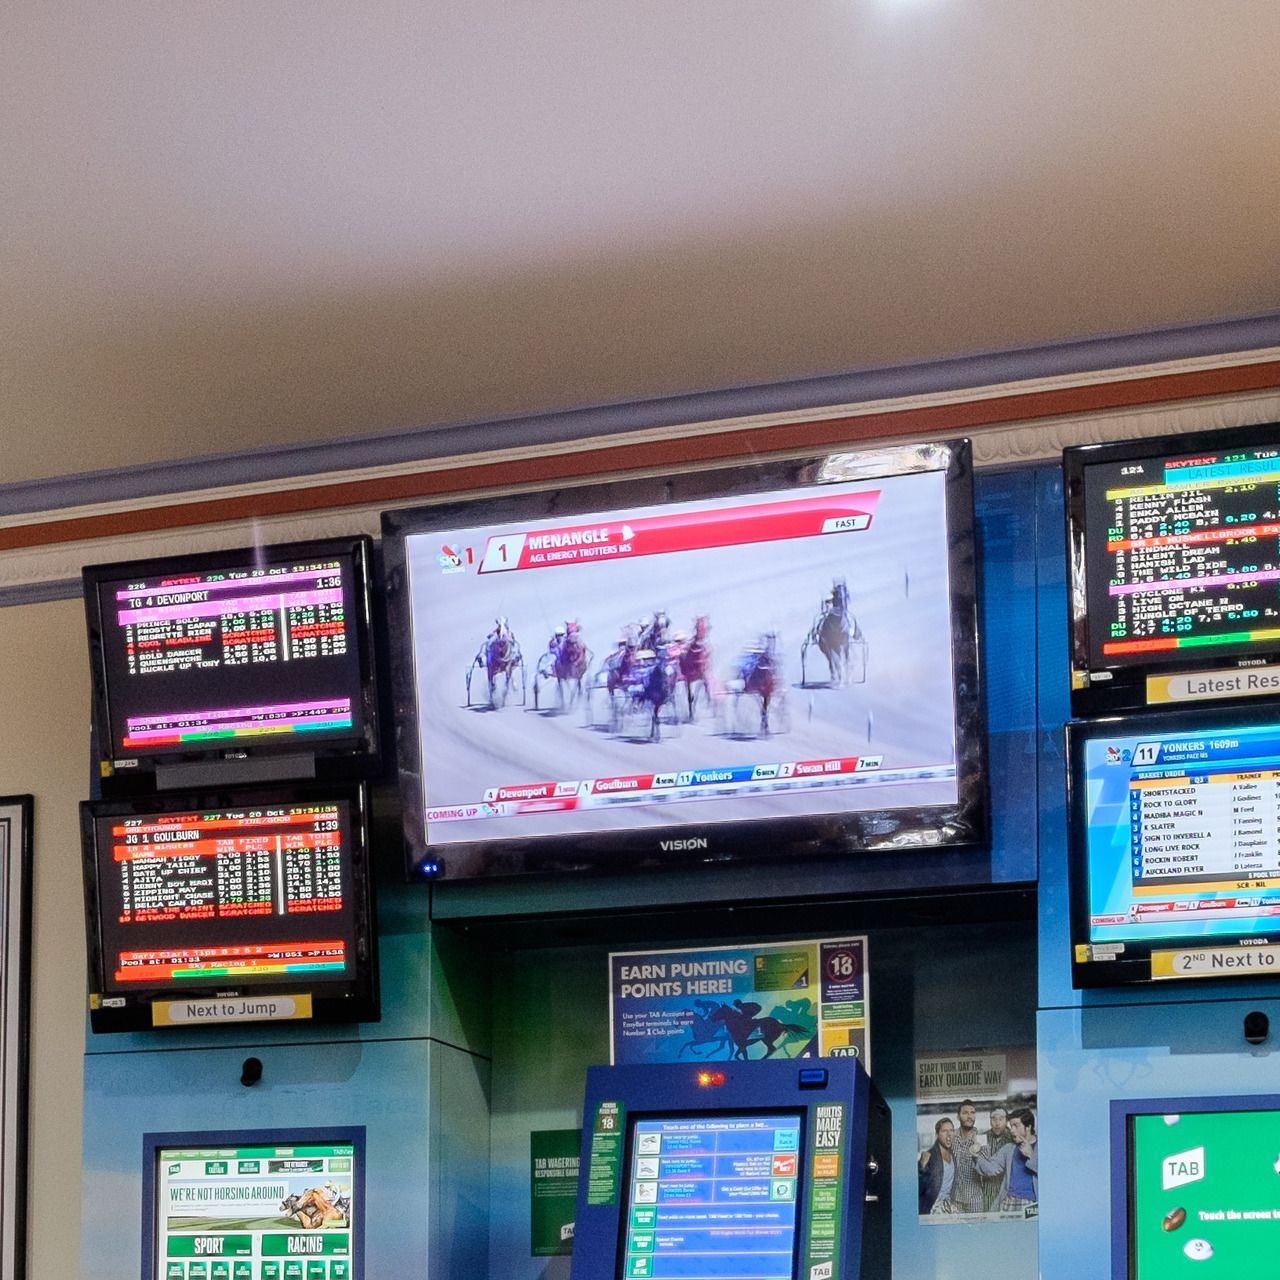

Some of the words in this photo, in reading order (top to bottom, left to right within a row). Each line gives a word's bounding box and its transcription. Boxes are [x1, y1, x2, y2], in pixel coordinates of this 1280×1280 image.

[1189, 465, 1232, 480] LATEST
[1130, 501, 1166, 510] KENNY
[1174, 496, 1211, 505] FLASH
[836, 519, 856, 527] FAST
[529, 528, 608, 549] MENANGLE
[498, 543, 507, 562] 1
[530, 555, 545, 563] AGL
[547, 552, 577, 561] ENERGY
[579, 546, 617, 557] TROTTERS
[1131, 552, 1174, 562] SILENT
[1182, 548, 1220, 556] DREAM
[1131, 560, 1175, 569] HAMISH
[1160, 565, 1190, 574] WILD
[1197, 562, 1227, 570] SIDE
[317, 577, 341, 588] 1:36
[129, 599, 141, 608] TG
[146, 597, 152, 606] 4
[158, 591, 208, 605] DEVONPORT
[1238, 659, 1266, 667] TOYODA
[1187, 676, 1240, 694] Latest
[1139, 748, 1153, 760] 11
[1163, 742, 1205, 753] YONKERS
[1210, 740, 1239, 749] 1609m
[796, 763, 822, 774] Swan
[825, 760, 841, 772] Hill
[695, 771, 732, 782] Yonkers
[596, 779, 638, 791] Goulburn
[488, 791, 493, 799] 4
[500, 787, 547, 799] Devonport
[428, 810, 463, 820] COMING
[467, 809, 478, 817] UP
[314, 820, 338, 831] 1:39
[126, 835, 138, 843] JG
[143, 834, 149, 843] 1
[154, 830, 200, 842] GOULBURN
[660, 838, 708, 851] VISION
[1146, 867, 1182, 875] AUCKLAND
[832, 957, 853, 975] 18
[1212, 950, 1252, 968] Next
[1258, 952, 1274, 966] to
[621, 964, 665, 980] EARN
[671, 960, 747, 977] PUNTING
[621, 982, 682, 998] POINTS
[687, 979, 732, 995] HERE!
[187, 1004, 217, 1017] Next
[222, 1003, 235, 1015] to
[239, 1001, 277, 1016] Jump
[833, 1048, 855, 1056] TAB
[920, 1063, 938, 1073] START
[940, 1062, 956, 1072] YOUR
[958, 1061, 970, 1071] DAY
[972, 1061, 983, 1071] THE
[920, 1073, 943, 1088] EARLY
[946, 1072, 981, 1087] QUADDIE
[984, 1071, 1002, 1084] WAY
[817, 1106, 842, 1119] MULTIS
[601, 1119, 613, 1129] 18
[816, 1118, 841, 1132] MADE
[815, 1132, 840, 1148] EASY
[535, 1159, 546, 1169] TAB
[1168, 1161, 1199, 1176] TAB
[170, 1187, 196, 1201] WE'RE
[197, 1187, 213, 1200] NOT
[214, 1186, 250, 1200] HORSING
[251, 1186, 285, 1199] AROUND
[1198, 1211, 1224, 1220] Touch
[1227, 1210, 1241, 1220] the
[1243, 1210, 1271, 1219] screen
[194, 1238, 225, 1254] SPORT
[287, 1236, 323, 1253] RACING
[813, 1268, 829, 1276] TAB
